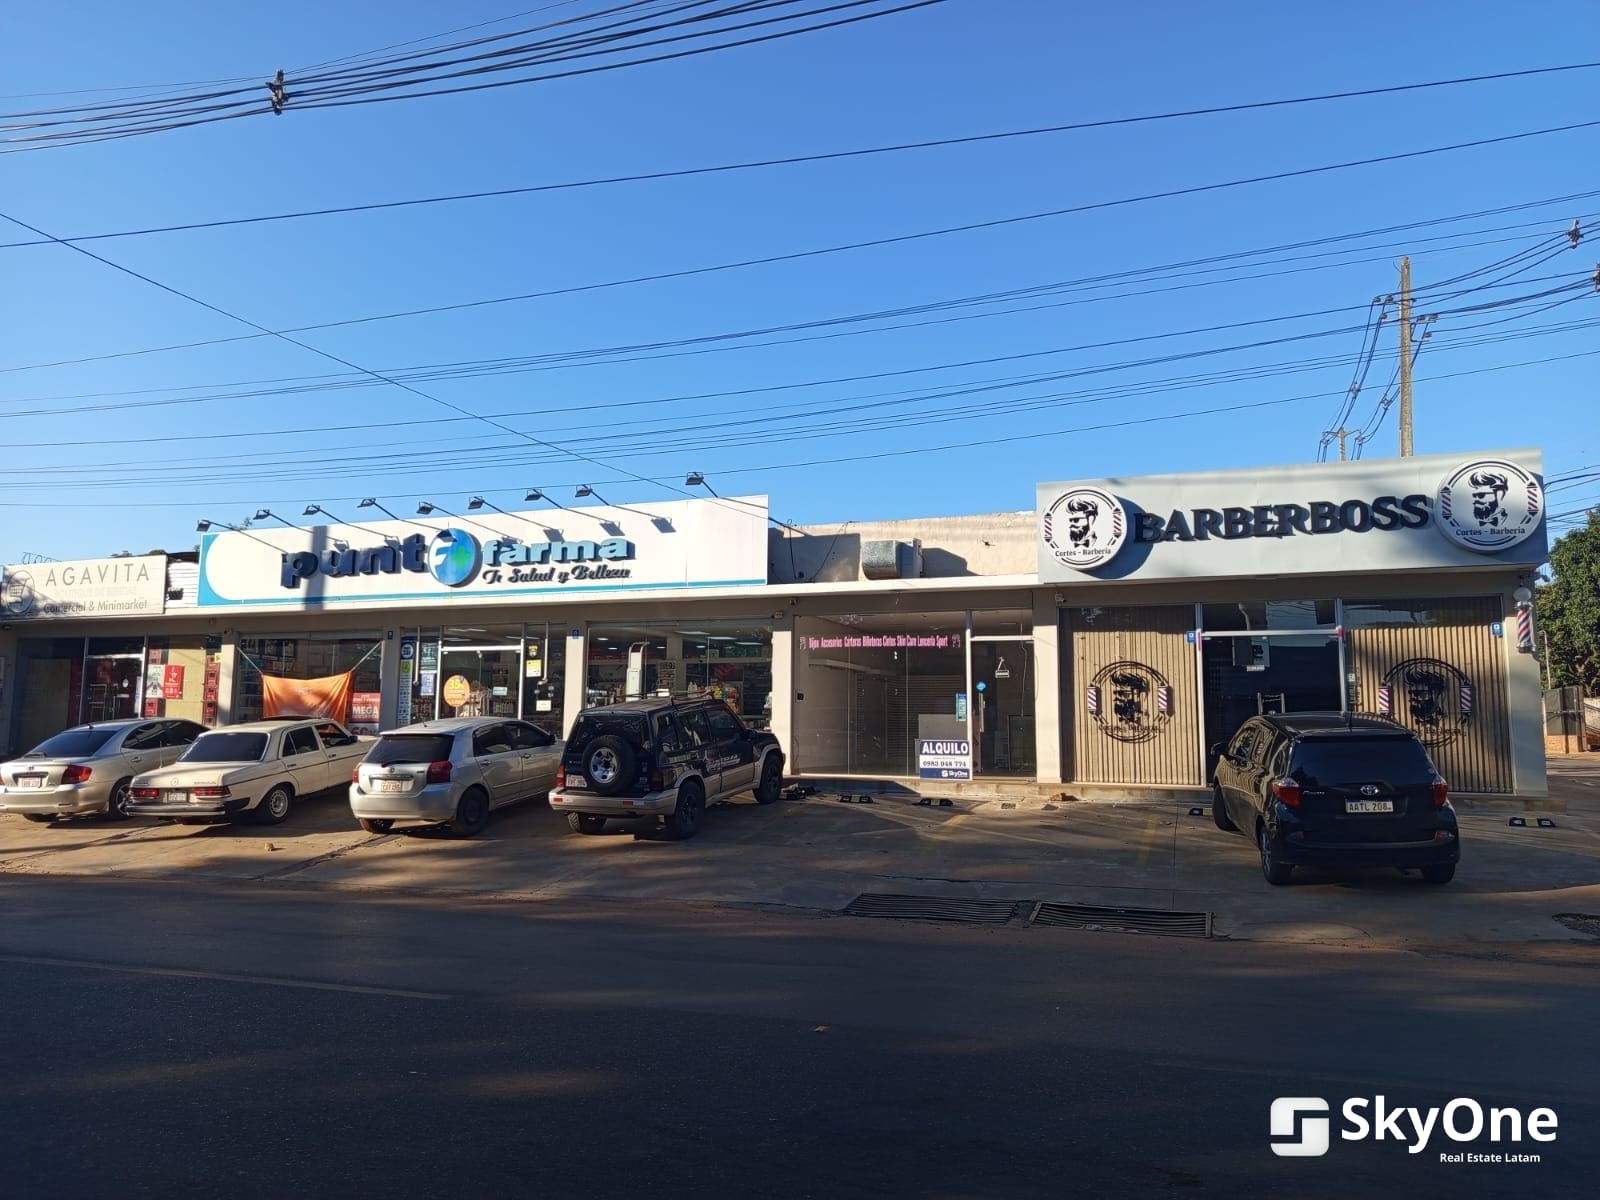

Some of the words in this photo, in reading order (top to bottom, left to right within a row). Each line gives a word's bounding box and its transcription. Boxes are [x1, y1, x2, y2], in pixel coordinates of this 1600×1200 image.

[1134, 494, 1431, 543] BARBERBOSS
[482, 537, 632, 566] farma
[46, 562, 150, 587] AGAVITA
[507, 567, 554, 584] Salud
[557, 571, 570, 584] y
[571, 564, 631, 581] Belleza
[88, 601, 95, 611] &
[97, 598, 148, 611] Minimarket
[936, 635, 948, 648] Sport
[353, 706, 379, 716] MEGA
[922, 742, 969, 754] ALQUILO
[1349, 802, 1370, 812] AATL
[1372, 802, 1388, 811] 208
